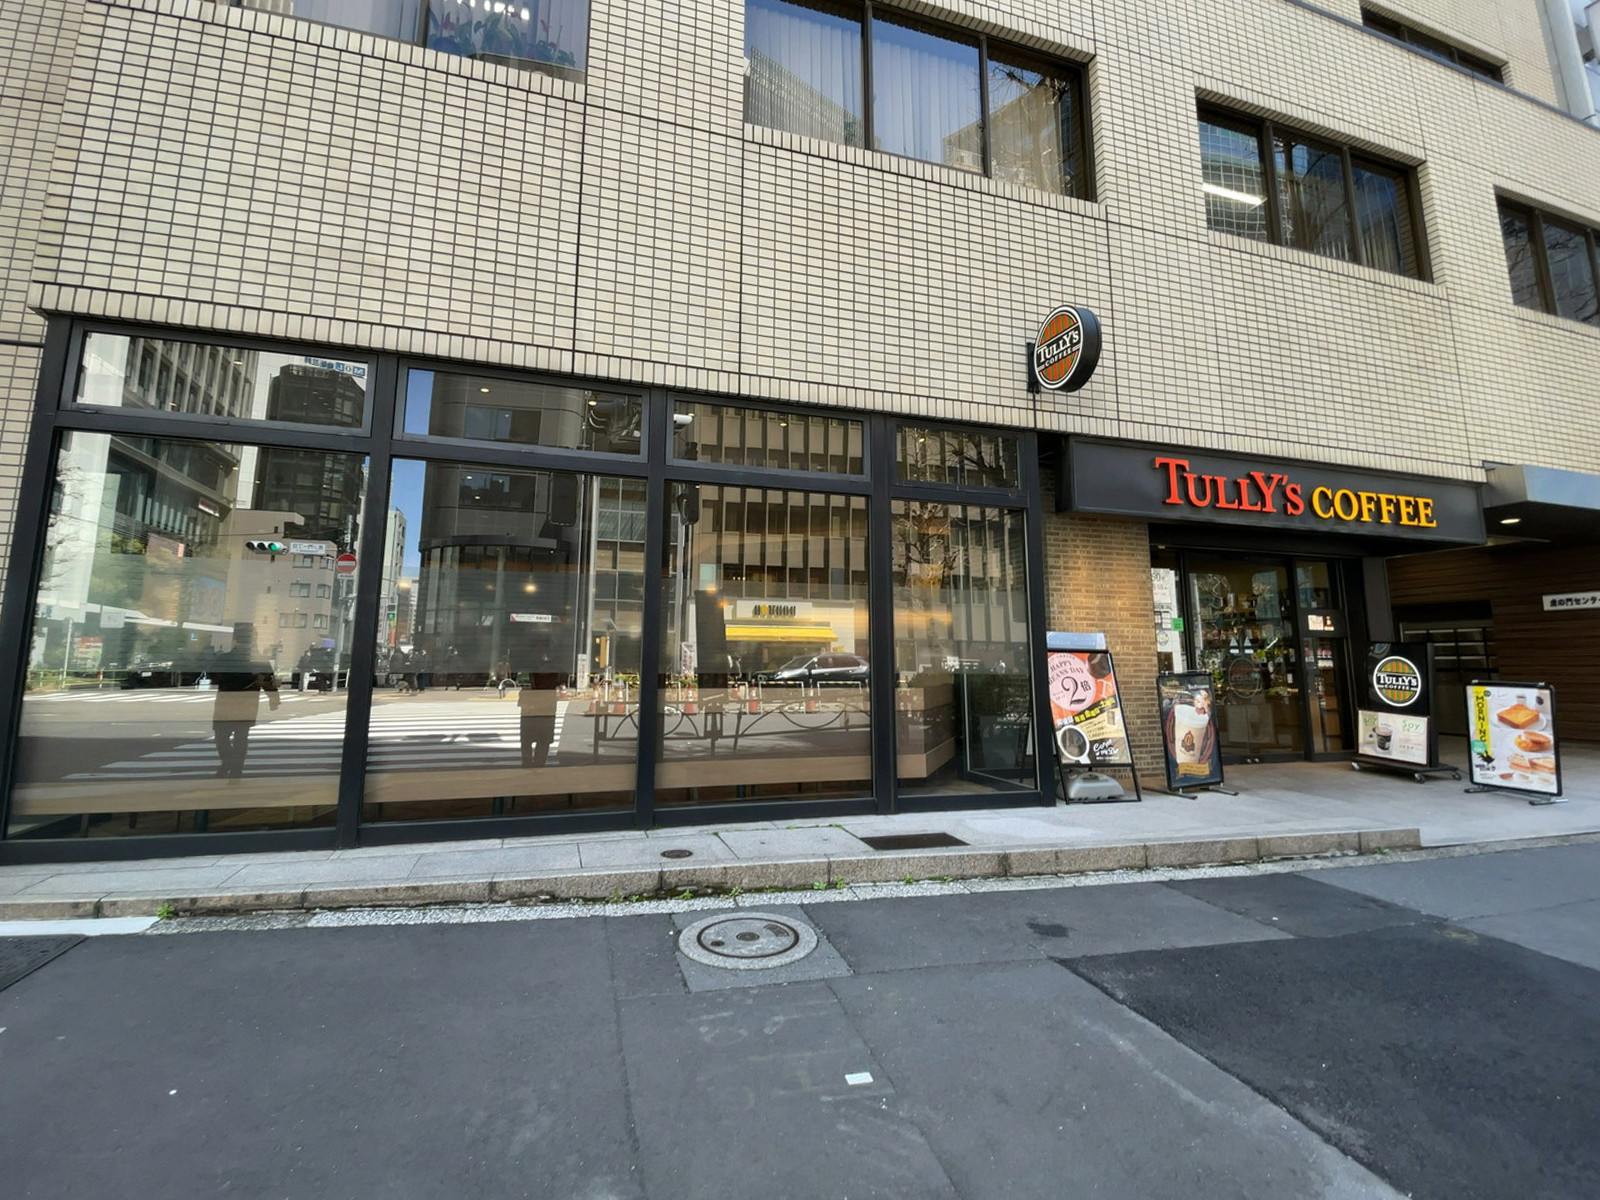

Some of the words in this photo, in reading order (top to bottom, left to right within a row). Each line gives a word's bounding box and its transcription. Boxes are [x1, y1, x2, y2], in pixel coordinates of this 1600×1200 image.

[1038, 330, 1079, 362] TULLY'S
[1045, 347, 1072, 367] COFFEE
[1155, 457, 1305, 516] TULLY'S
[1312, 486, 1437, 528] COFFEE
[1550, 596, 1600, 607] 虎の門センタ
[1050, 660, 1072, 672] HAPPY
[1377, 673, 1417, 687] TULLY'S
